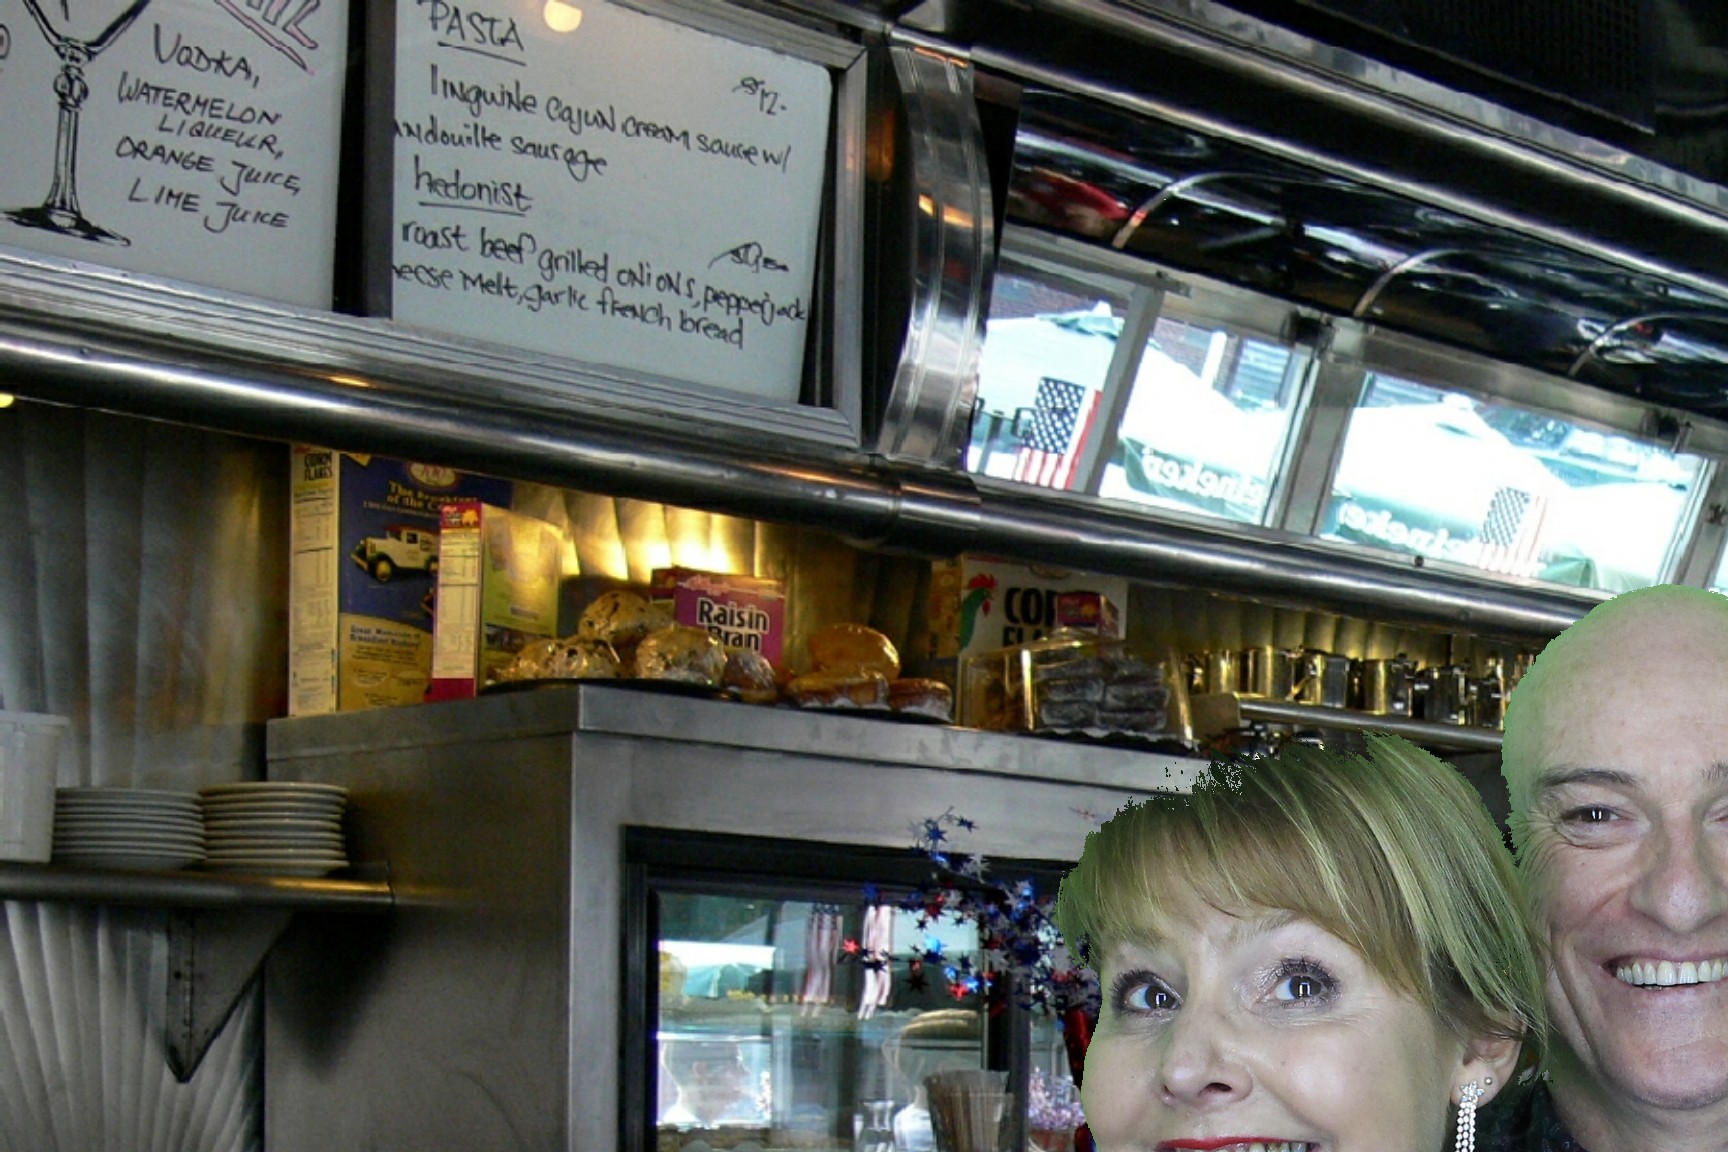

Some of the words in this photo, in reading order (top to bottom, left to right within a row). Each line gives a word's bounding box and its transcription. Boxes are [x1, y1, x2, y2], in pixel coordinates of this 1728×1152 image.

[117, 71, 281, 126] WATERMELON
[116, 136, 215, 173] ORANGE
[128, 178, 201, 212] LIME
[204, 201, 290, 234] JUICE
[413, 154, 533, 212] hedonist
[679, 309, 744, 350] bread
[697, 598, 769, 633] Raisin
